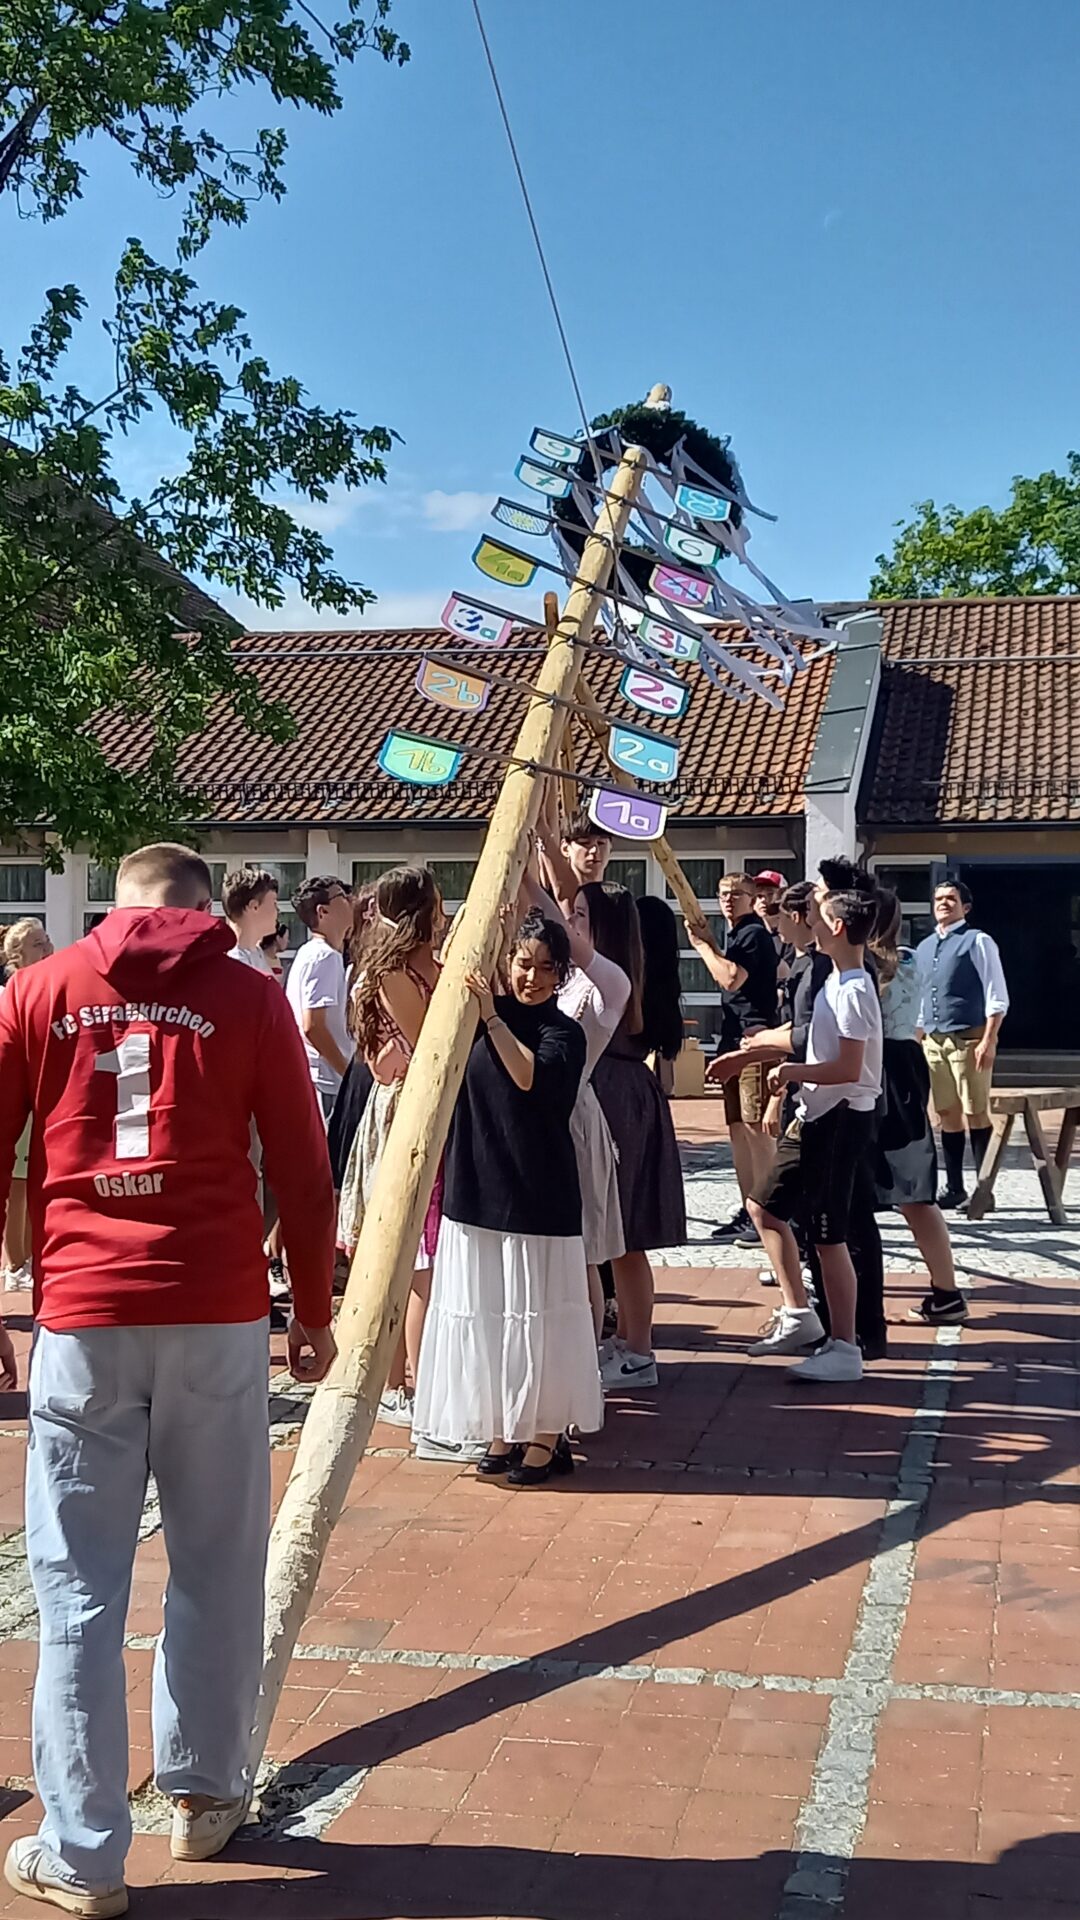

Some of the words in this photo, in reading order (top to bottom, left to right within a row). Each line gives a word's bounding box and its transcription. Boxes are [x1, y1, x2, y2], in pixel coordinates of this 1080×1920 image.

[687, 490, 717, 516] 8
[660, 575, 703, 601] 4b
[453, 607, 497, 641] 3a
[649, 624, 689, 656] 3b
[425, 672, 480, 704] 2b
[630, 673, 678, 709] 2c
[393, 748, 447, 776] 1b
[617, 738, 670, 774] 2a
[602, 800, 651, 831] 1a
[51, 1014, 78, 1041] FC
[79, 1002, 216, 1038] Straßkirchen
[94, 1033, 151, 1160] 1
[93, 1171, 165, 1198] Oskar
